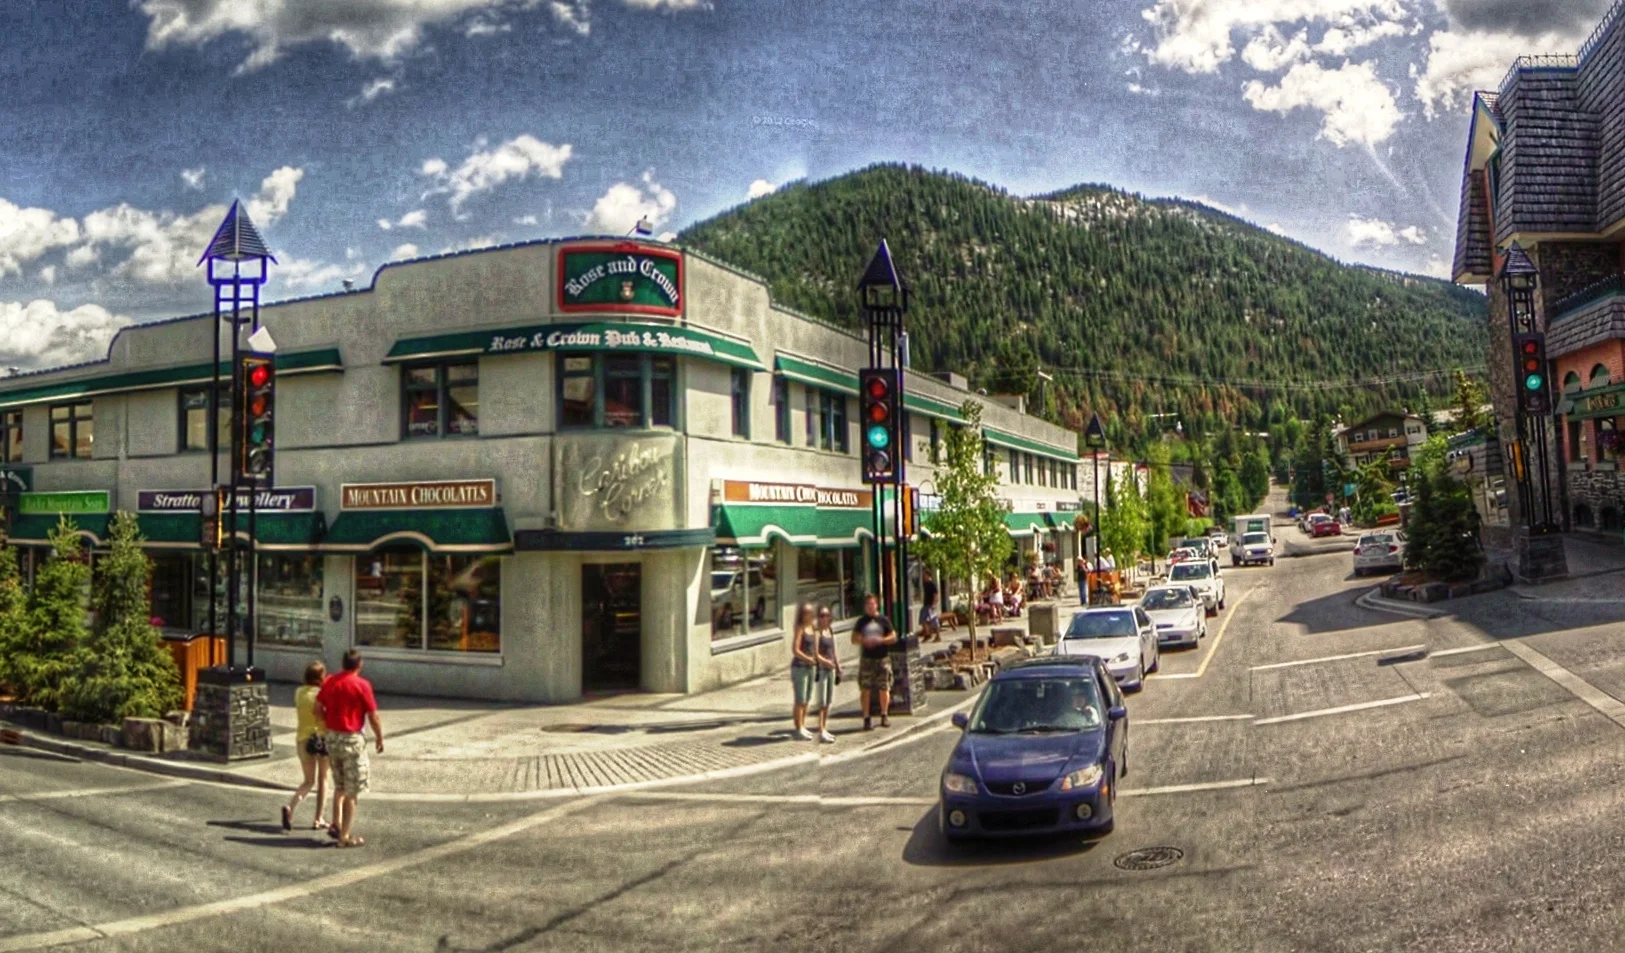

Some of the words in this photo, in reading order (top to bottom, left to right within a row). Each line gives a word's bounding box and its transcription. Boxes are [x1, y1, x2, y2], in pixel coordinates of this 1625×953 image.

[564, 265, 606, 297] Rose
[607, 256, 637, 274] and
[640, 259, 679, 303] Crown
[490, 335, 526, 350] Rose
[530, 332, 544, 348] &
[546, 331, 600, 347] Crown
[604, 329, 640, 347] Pub
[642, 332, 658, 347] &
[153, 493, 201, 508] Stratto
[348, 488, 407, 506] MOUNTAIN
[411, 484, 487, 505] CHOCOLATES
[750, 482, 796, 500] MOUNTAIN
